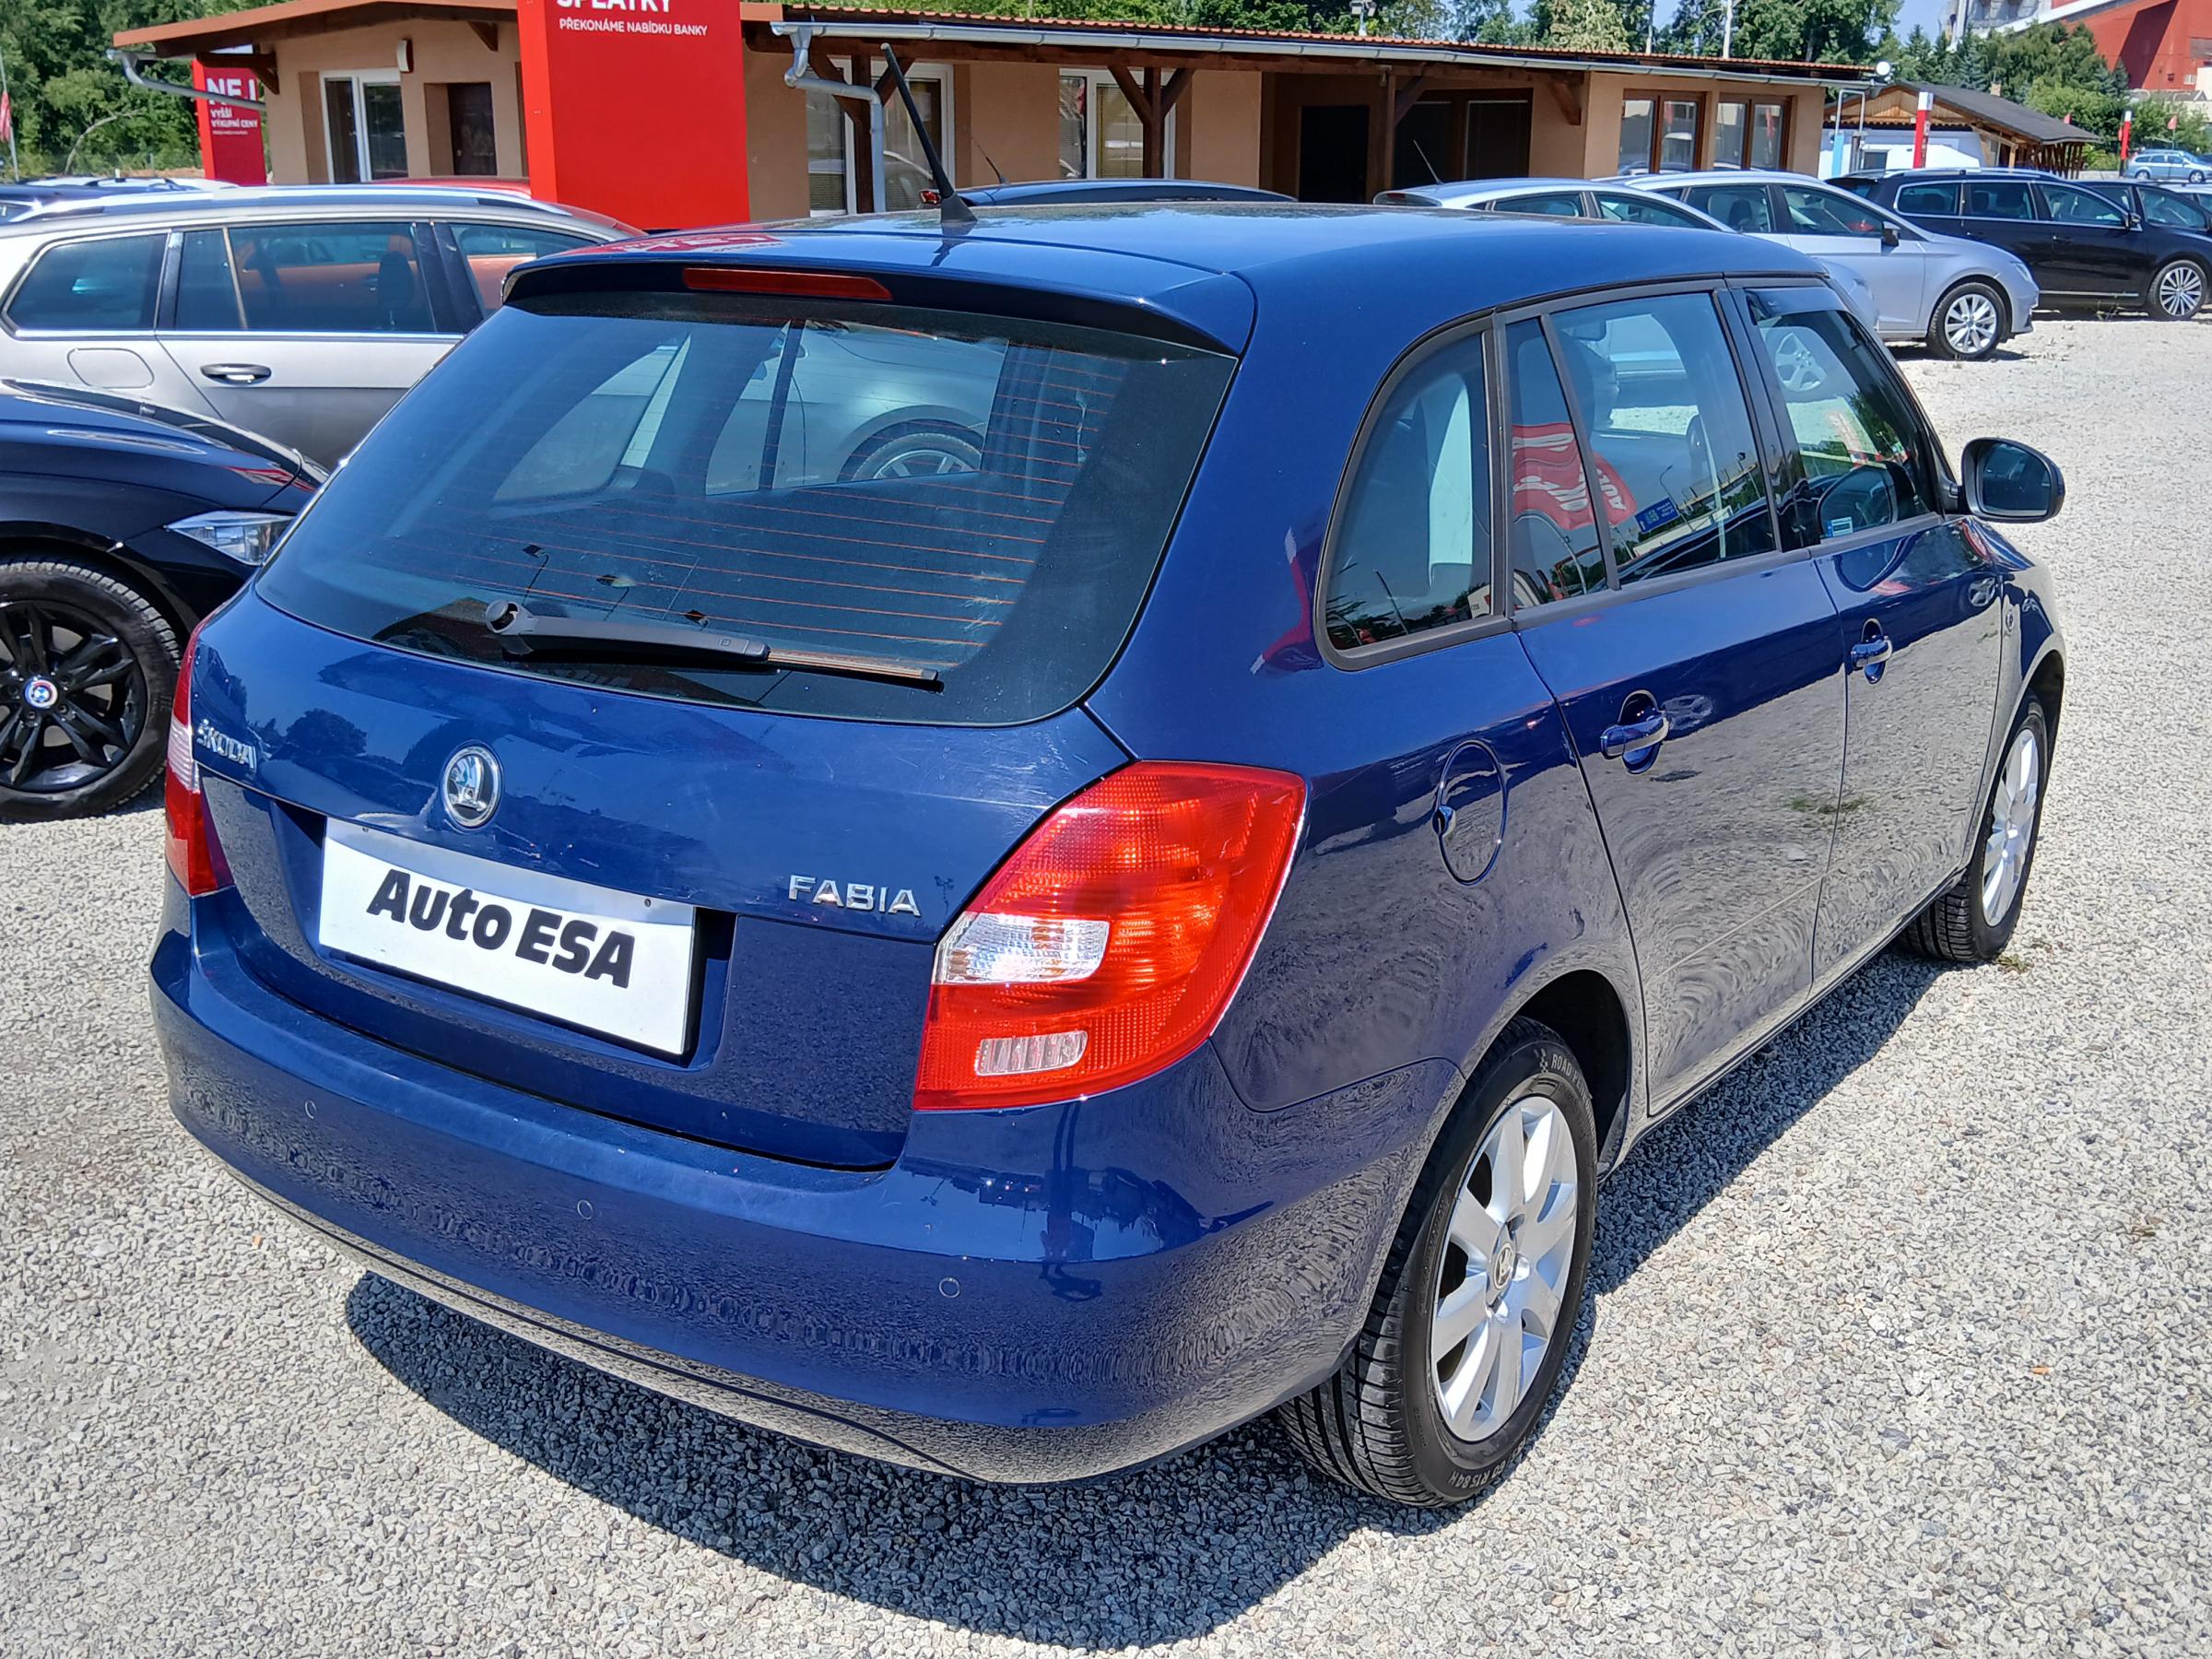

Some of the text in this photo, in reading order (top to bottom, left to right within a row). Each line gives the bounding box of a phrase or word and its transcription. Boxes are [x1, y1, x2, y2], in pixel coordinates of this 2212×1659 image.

[559, 17, 708, 36] PŘEKONÁME NABÍDKU BANKY
[196, 719, 256, 771] ŠKODA
[788, 875, 922, 917] FABIA
[366, 868, 635, 989] Auto ESA
